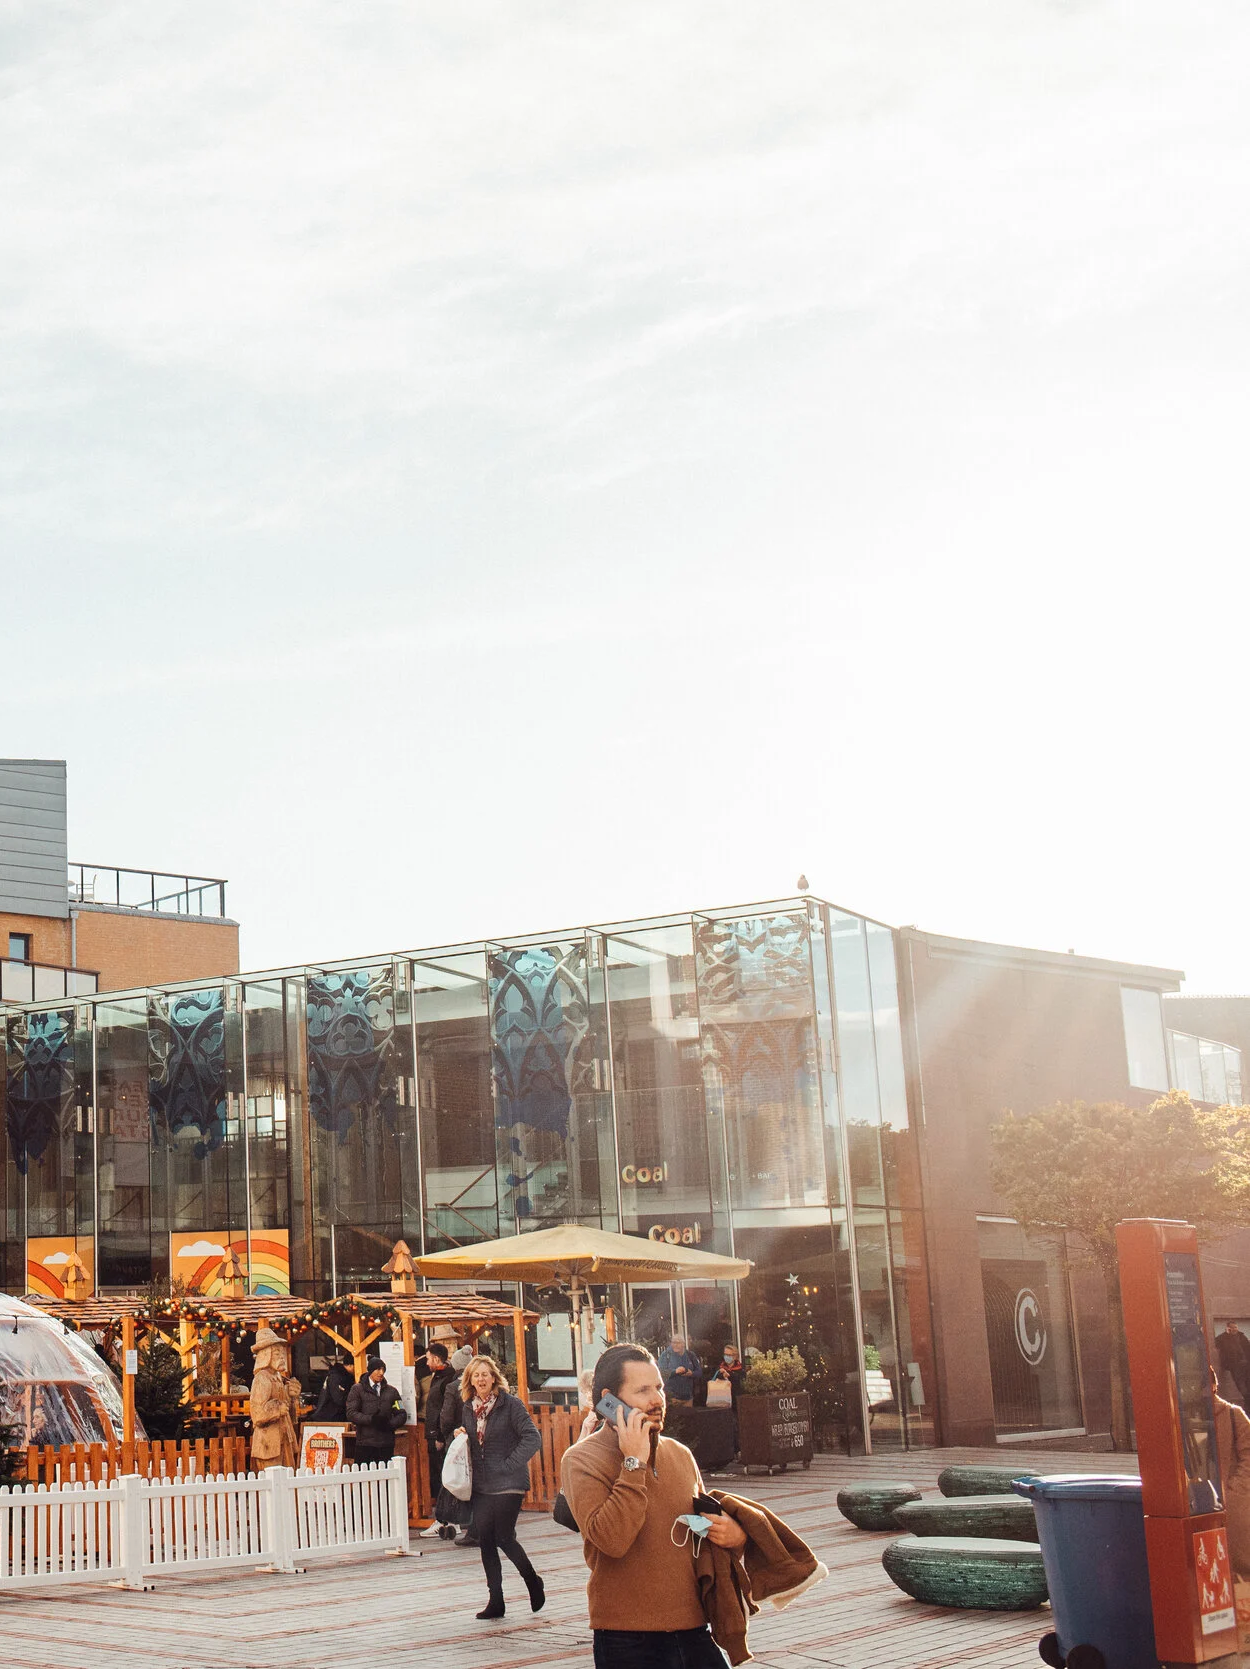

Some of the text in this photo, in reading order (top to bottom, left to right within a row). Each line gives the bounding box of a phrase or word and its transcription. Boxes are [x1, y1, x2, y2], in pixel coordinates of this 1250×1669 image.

[621, 1161, 668, 1184] Coal
[648, 1221, 701, 1245] Coal
[779, 1397, 798, 1410] COAL
[311, 1440, 335, 1449] BROTHERS
